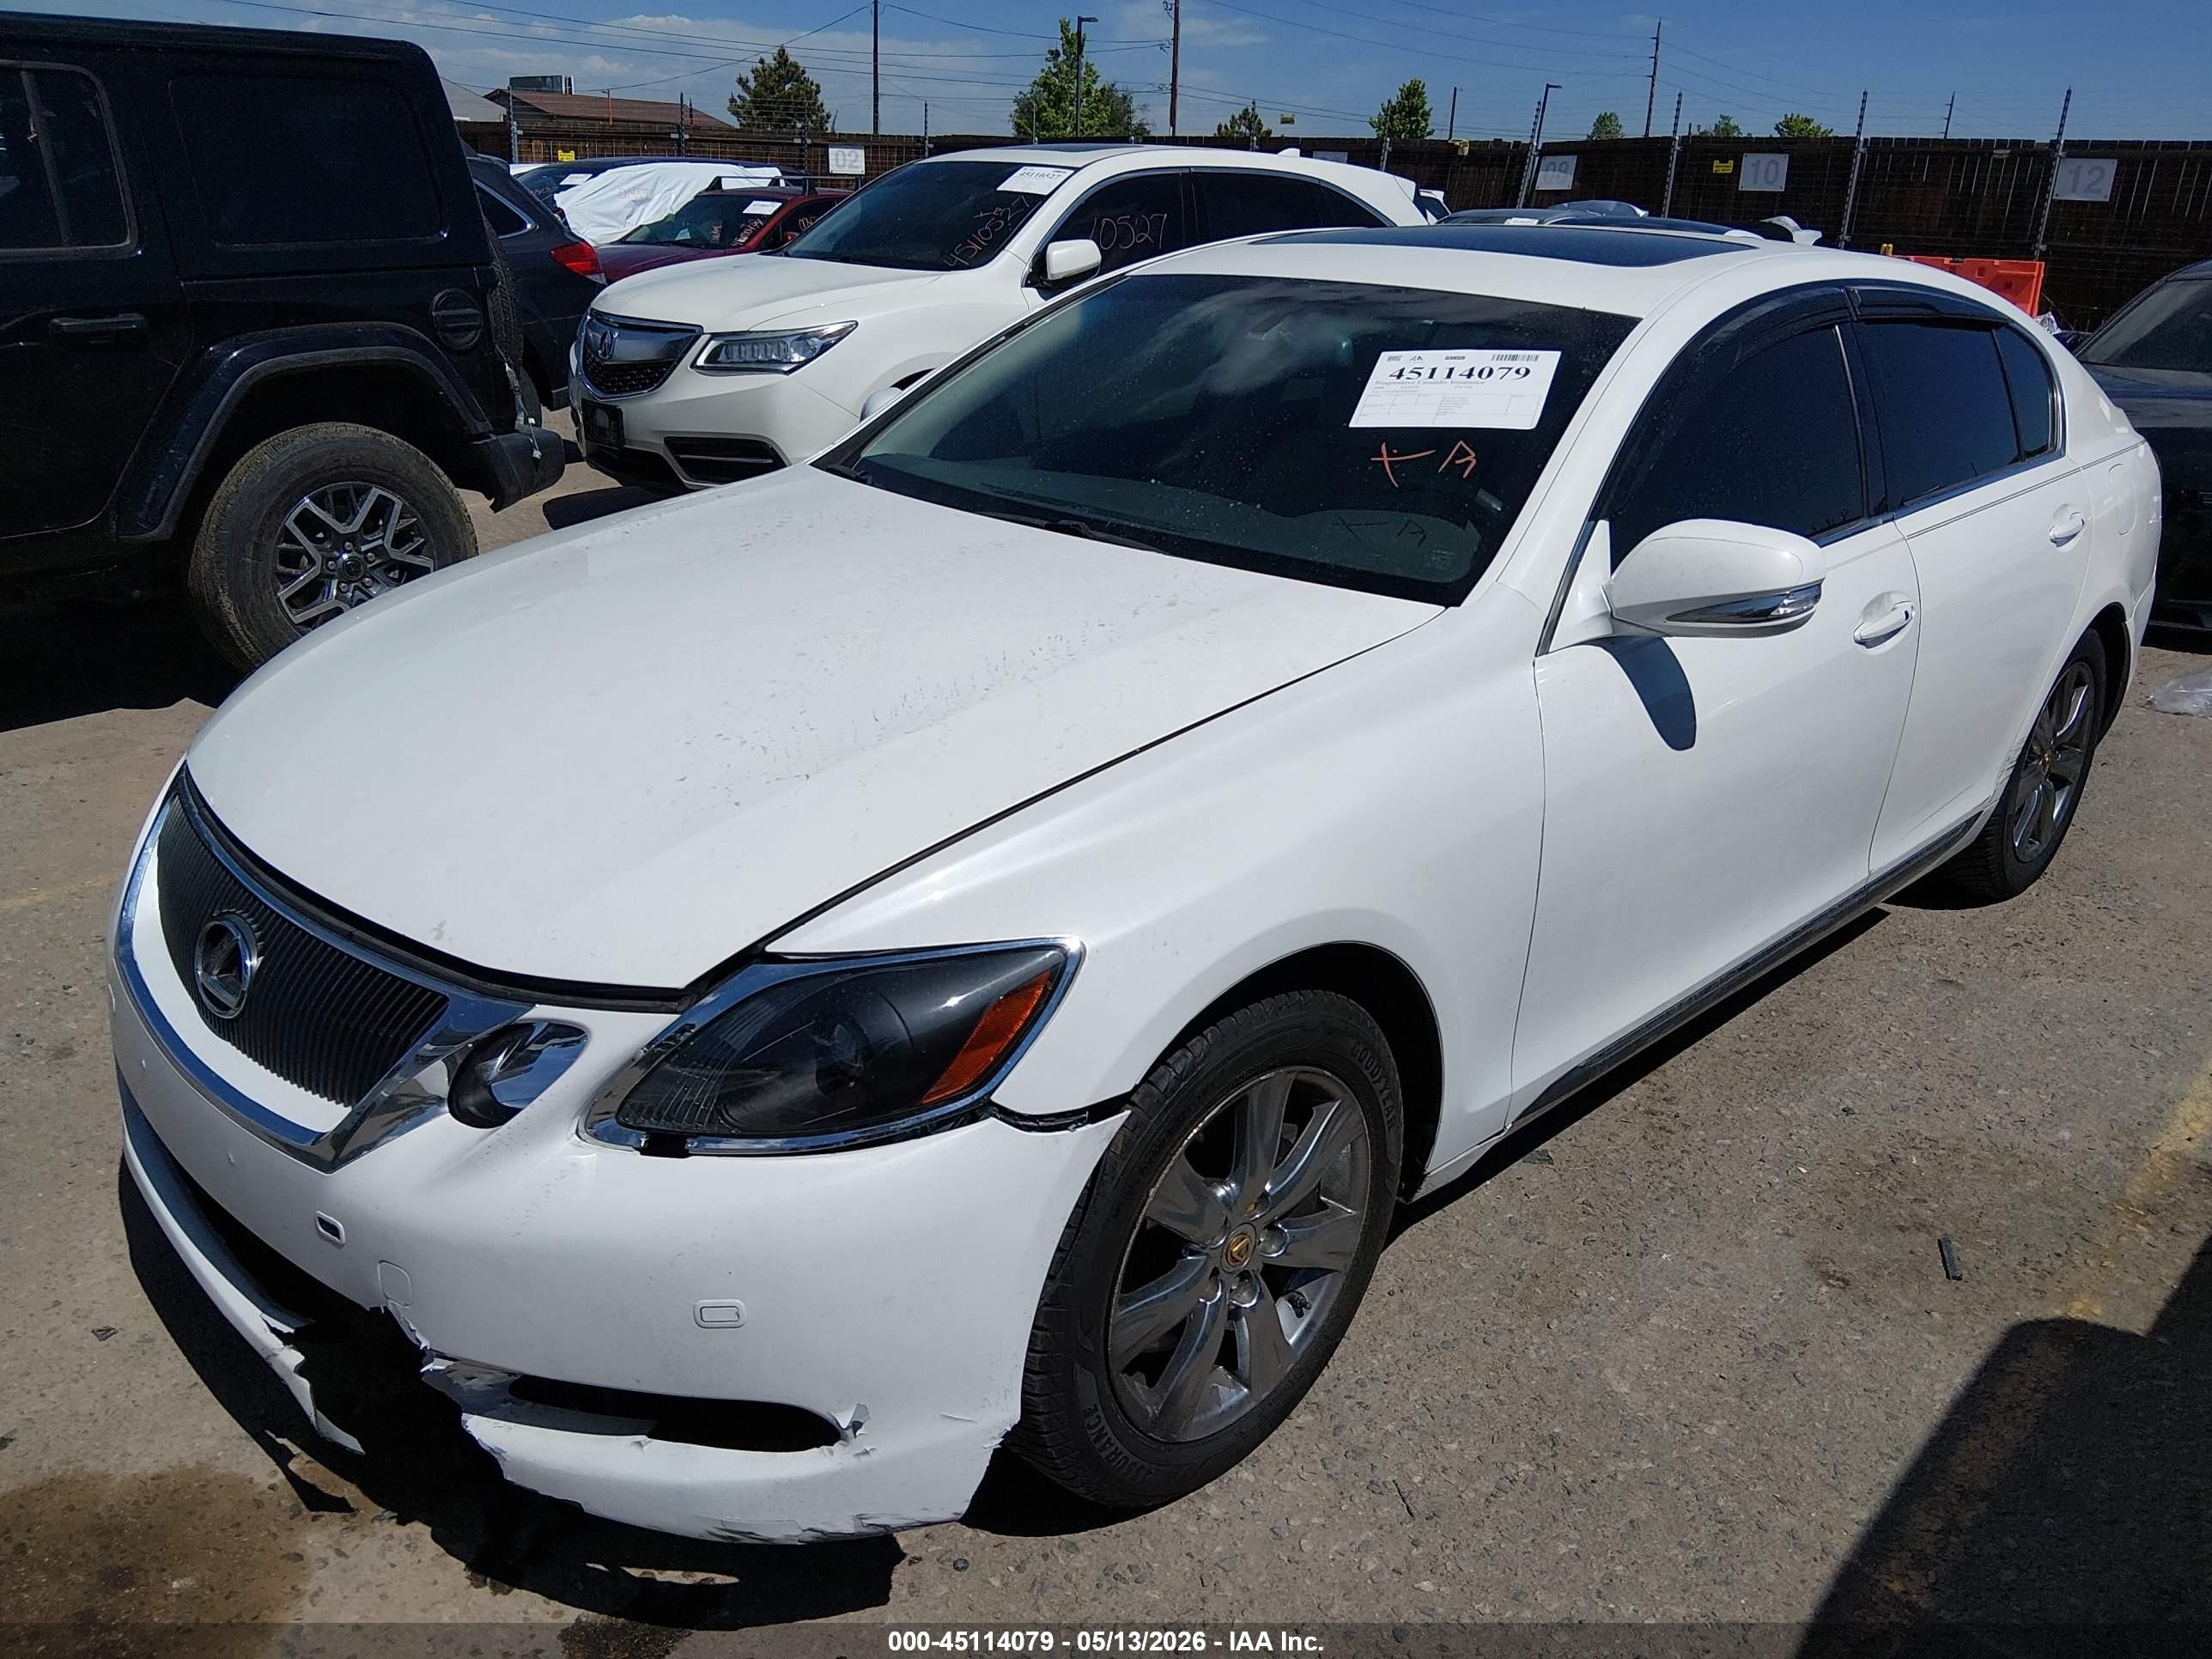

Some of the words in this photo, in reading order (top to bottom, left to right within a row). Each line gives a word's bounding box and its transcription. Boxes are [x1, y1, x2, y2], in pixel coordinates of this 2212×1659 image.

[835, 149, 860, 169] 02
[1752, 159, 1779, 185] 10
[2068, 165, 2106, 193] 12
[1089, 213, 1168, 250] 10527
[1389, 366, 1531, 380] 45114079
[1351, 1042, 1396, 1132] GOODYEAR
